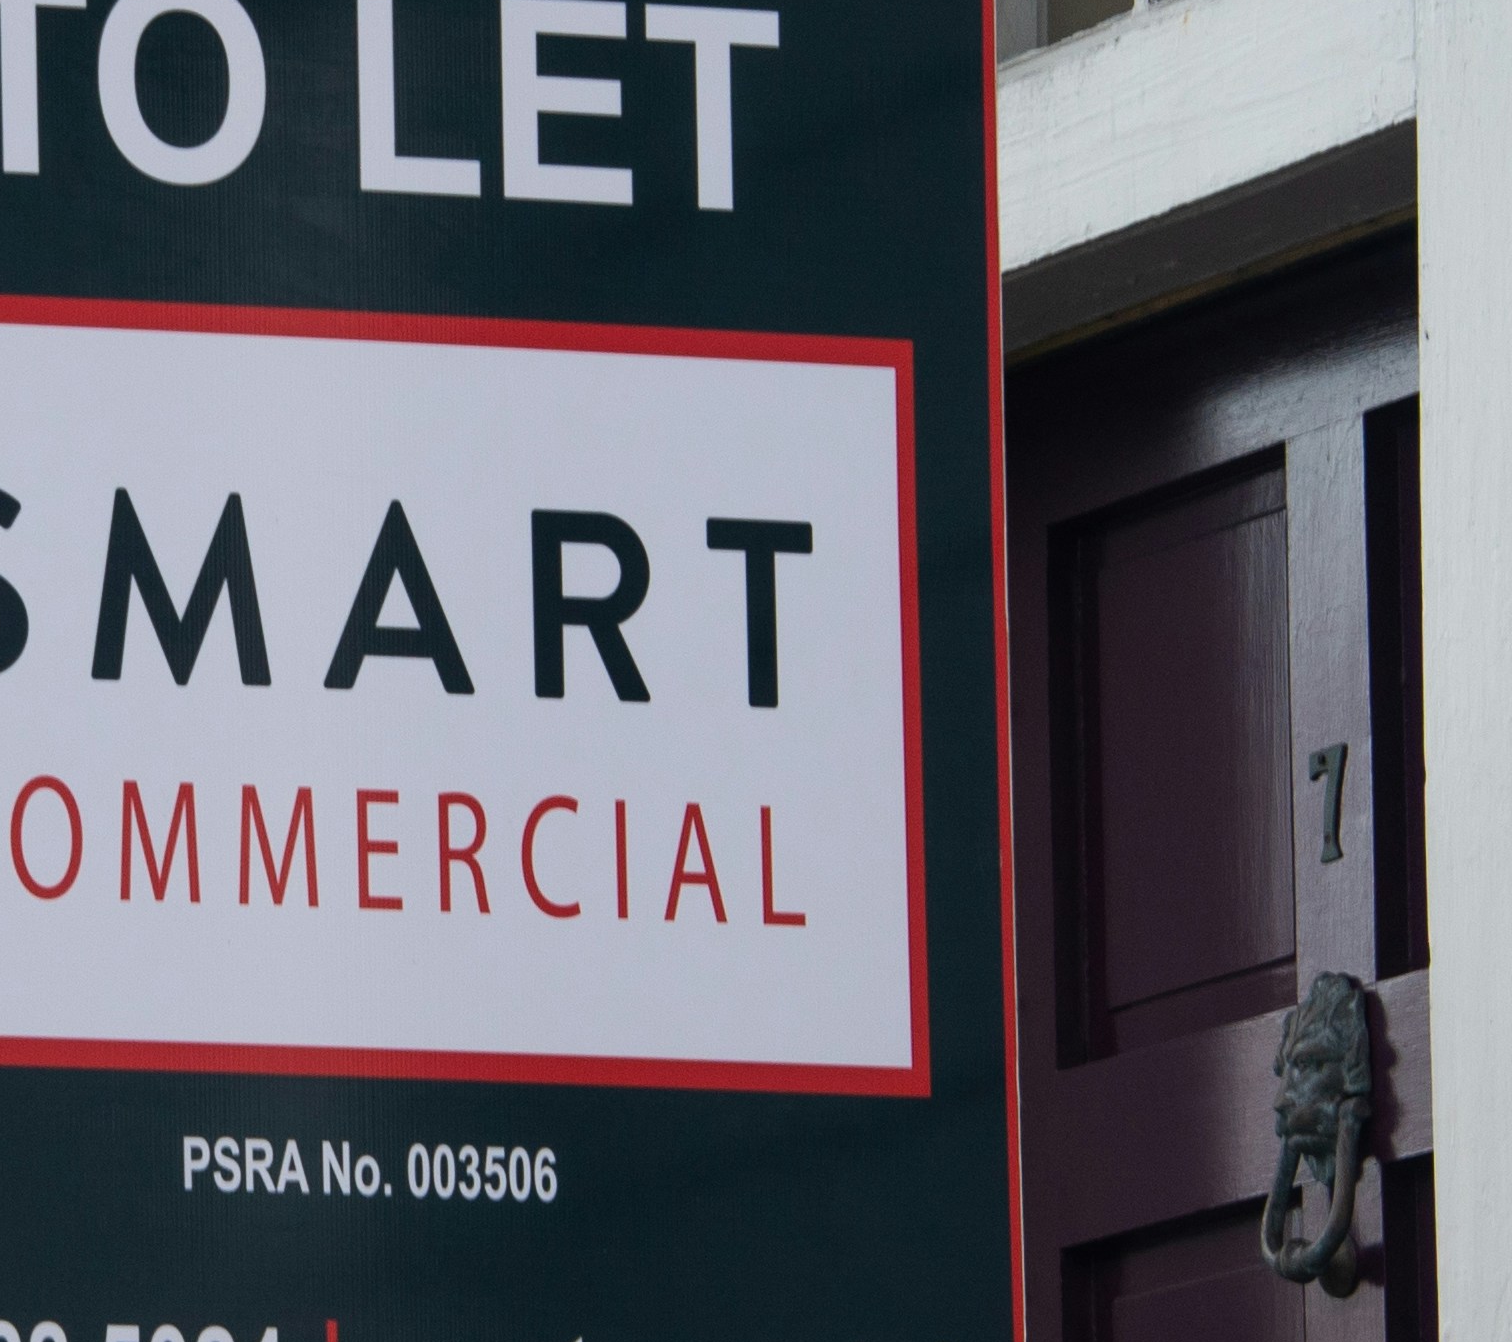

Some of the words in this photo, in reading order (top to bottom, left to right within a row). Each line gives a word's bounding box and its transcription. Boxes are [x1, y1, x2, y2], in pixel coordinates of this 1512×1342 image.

[1308, 742, 1349, 863] 7
[183, 1136, 310, 1194] PSRA
[322, 1140, 392, 1197] No.
[407, 1143, 558, 1202] 003506
